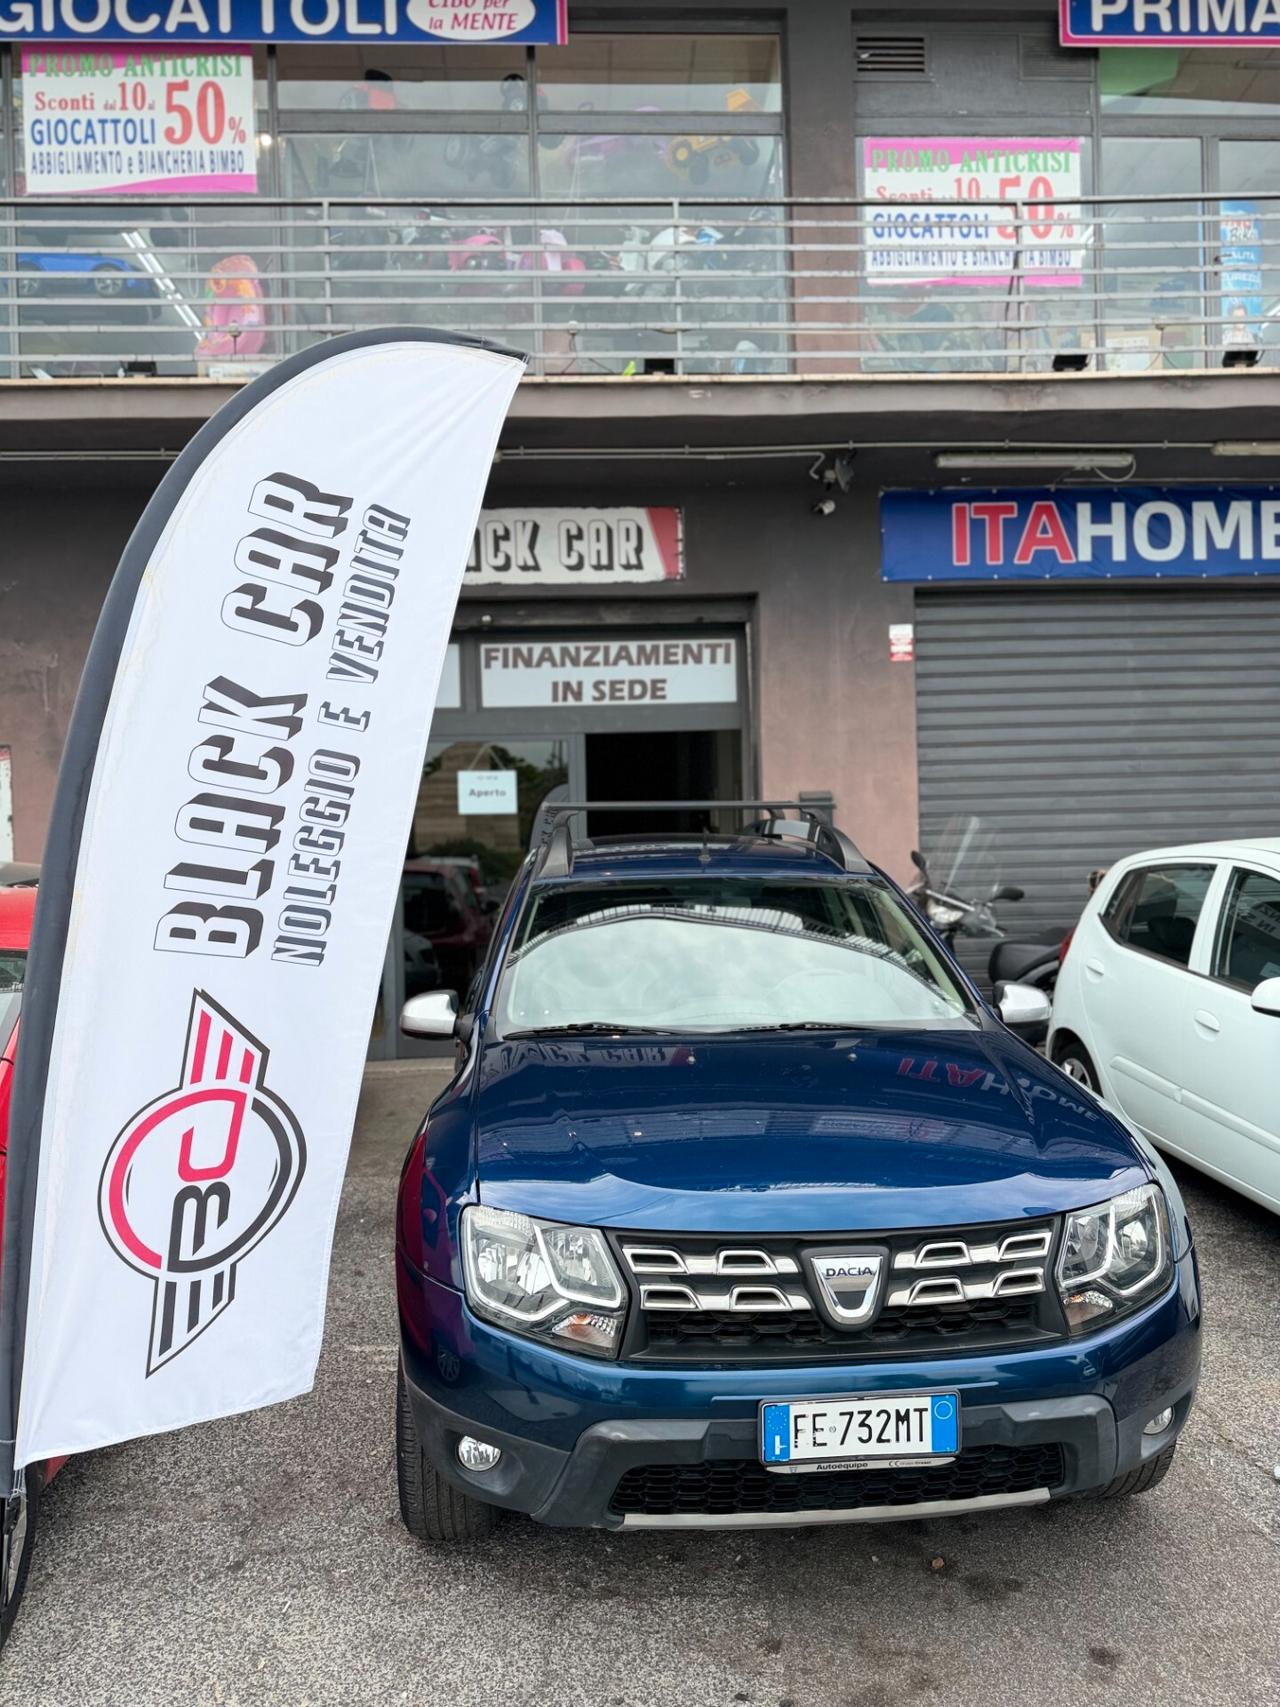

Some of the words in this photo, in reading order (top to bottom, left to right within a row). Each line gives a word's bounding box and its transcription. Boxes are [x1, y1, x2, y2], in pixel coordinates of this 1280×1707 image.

[0, 0, 397, 36] GIOCATTOLI
[428, 16, 443, 30] la
[451, 12, 518, 31] MENTE
[29, 54, 113, 77] PROMO
[124, 54, 242, 77] ANTICRISI
[35, 91, 95, 111] Sconti
[118, 82, 146, 111] 10
[31, 118, 156, 145] GIOCATTOLI
[31, 151, 123, 174] ABBIGLIAMENTO
[138, 151, 205, 174] BIANCHERIA
[209, 151, 244, 173] BIMBO
[871, 149, 950, 173] PROMO
[959, 149, 1071, 173] ANTICRISI
[873, 213, 989, 239] GIOCATTOLI
[558, 518, 644, 572] CAR
[952, 500, 1280, 566] ITAHOME
[220, 471, 354, 647] CAR
[326, 503, 411, 684] VENDITA
[484, 642, 732, 670] FINANZIAMENTI
[552, 680, 584, 703] IN
[591, 679, 668, 703] SEDE
[317, 701, 371, 732] E
[468, 788, 507, 798] Aperto
[153, 675, 308, 958] BLACK
[270, 749, 361, 967] NOLEGGIO
[825, 1266, 873, 1277] DACIA
[839, 1407, 929, 1446] 732MT
